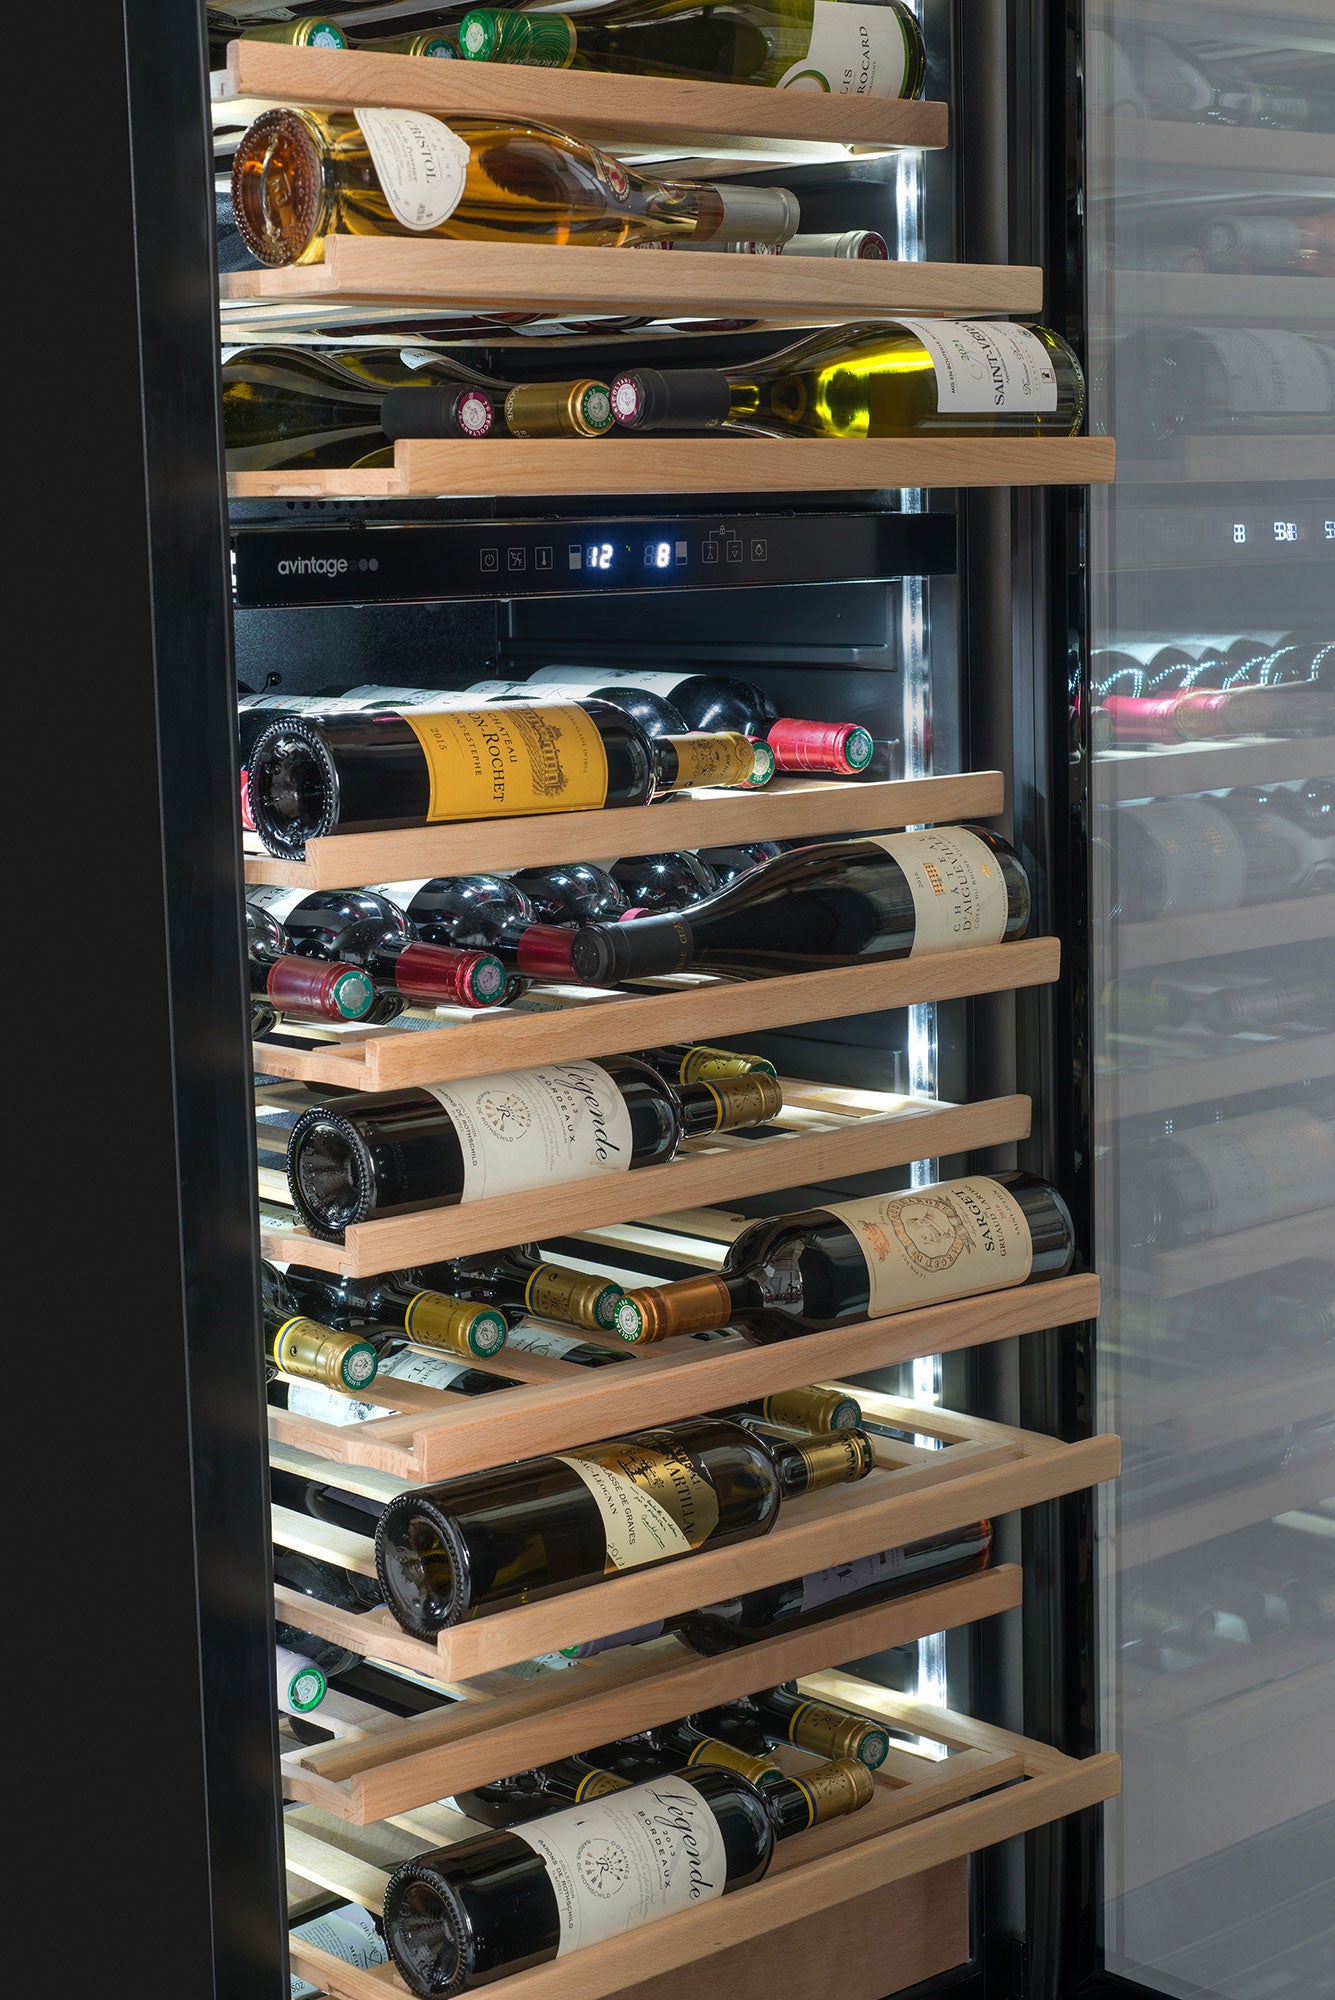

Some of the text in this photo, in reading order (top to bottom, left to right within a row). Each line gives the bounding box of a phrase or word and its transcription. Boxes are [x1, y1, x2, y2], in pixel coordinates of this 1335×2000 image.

[404, 119, 437, 184] CRISTOL
[277, 556, 348, 578] avintage
[591, 543, 614, 569] 12
[656, 542, 671, 568] 8
[430, 728, 448, 751] 2015
[538, 1074, 575, 1142] BORDEAUX
[553, 1064, 621, 1162] Légende
[563, 1090, 579, 1114] 2013
[455, 1108, 464, 1118] DE
[462, 1119, 478, 1166] ROTHSCHILD
[951, 1189, 995, 1252] SARGET
[989, 1215, 1007, 1257] GRUAUD
[619, 1493, 629, 1506] DE
[625, 1507, 637, 1546] GRAVES
[638, 1810, 671, 1889] BORDEAUX
[645, 1788, 714, 1901] Légende
[662, 1830, 676, 1857] 2013
[538, 1839, 574, 1929] BARONS DE ROTHSCHILD
